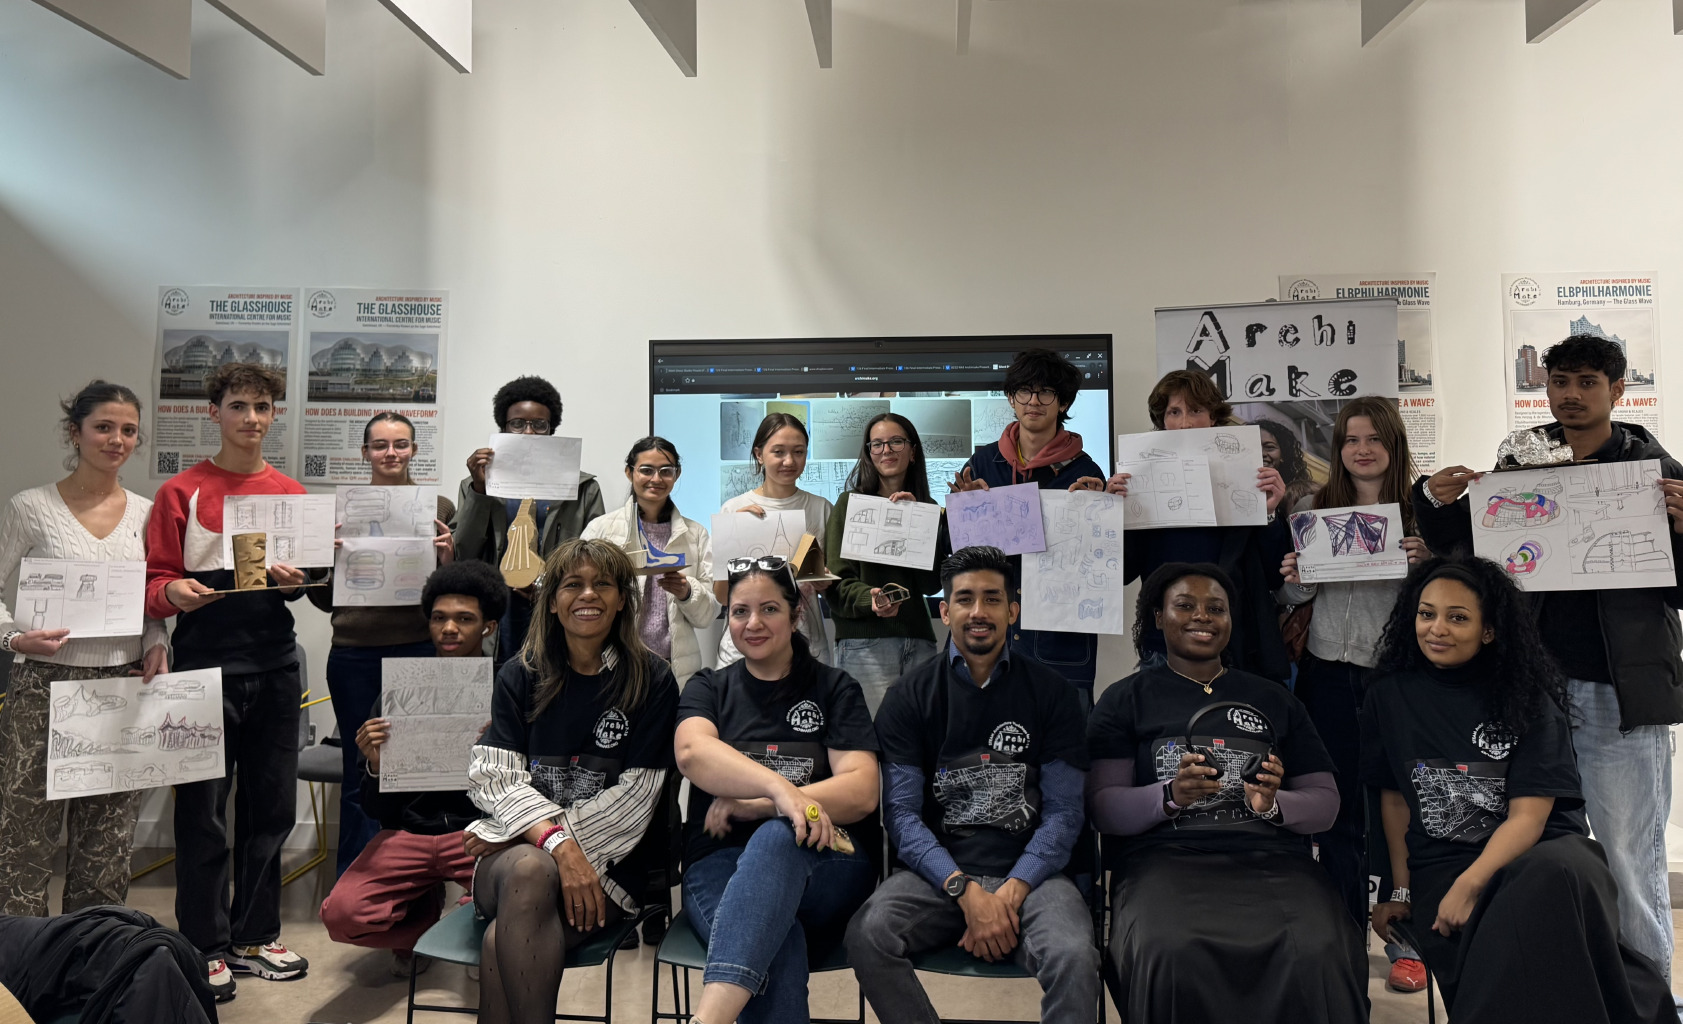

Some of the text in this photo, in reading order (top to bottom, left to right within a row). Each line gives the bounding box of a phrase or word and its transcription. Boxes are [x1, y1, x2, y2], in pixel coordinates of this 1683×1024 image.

[1336, 287, 1430, 299] ELBPHILHARMONIE
[1557, 285, 1652, 298] ELBPHILHARMONIE
[210, 300, 292, 313] THE GLASSHOUSE
[357, 303, 442, 316] THE GLASSHOUSE
[1186, 311, 1356, 354] Archi
[1186, 355, 1358, 400] Make
[1404, 399, 1408, 407] A
[1410, 399, 1434, 407] WAVE?
[1515, 400, 1531, 408] HOW
[1632, 398, 1657, 406] WAVE?
[400, 410, 438, 418] WAVEFORM?
